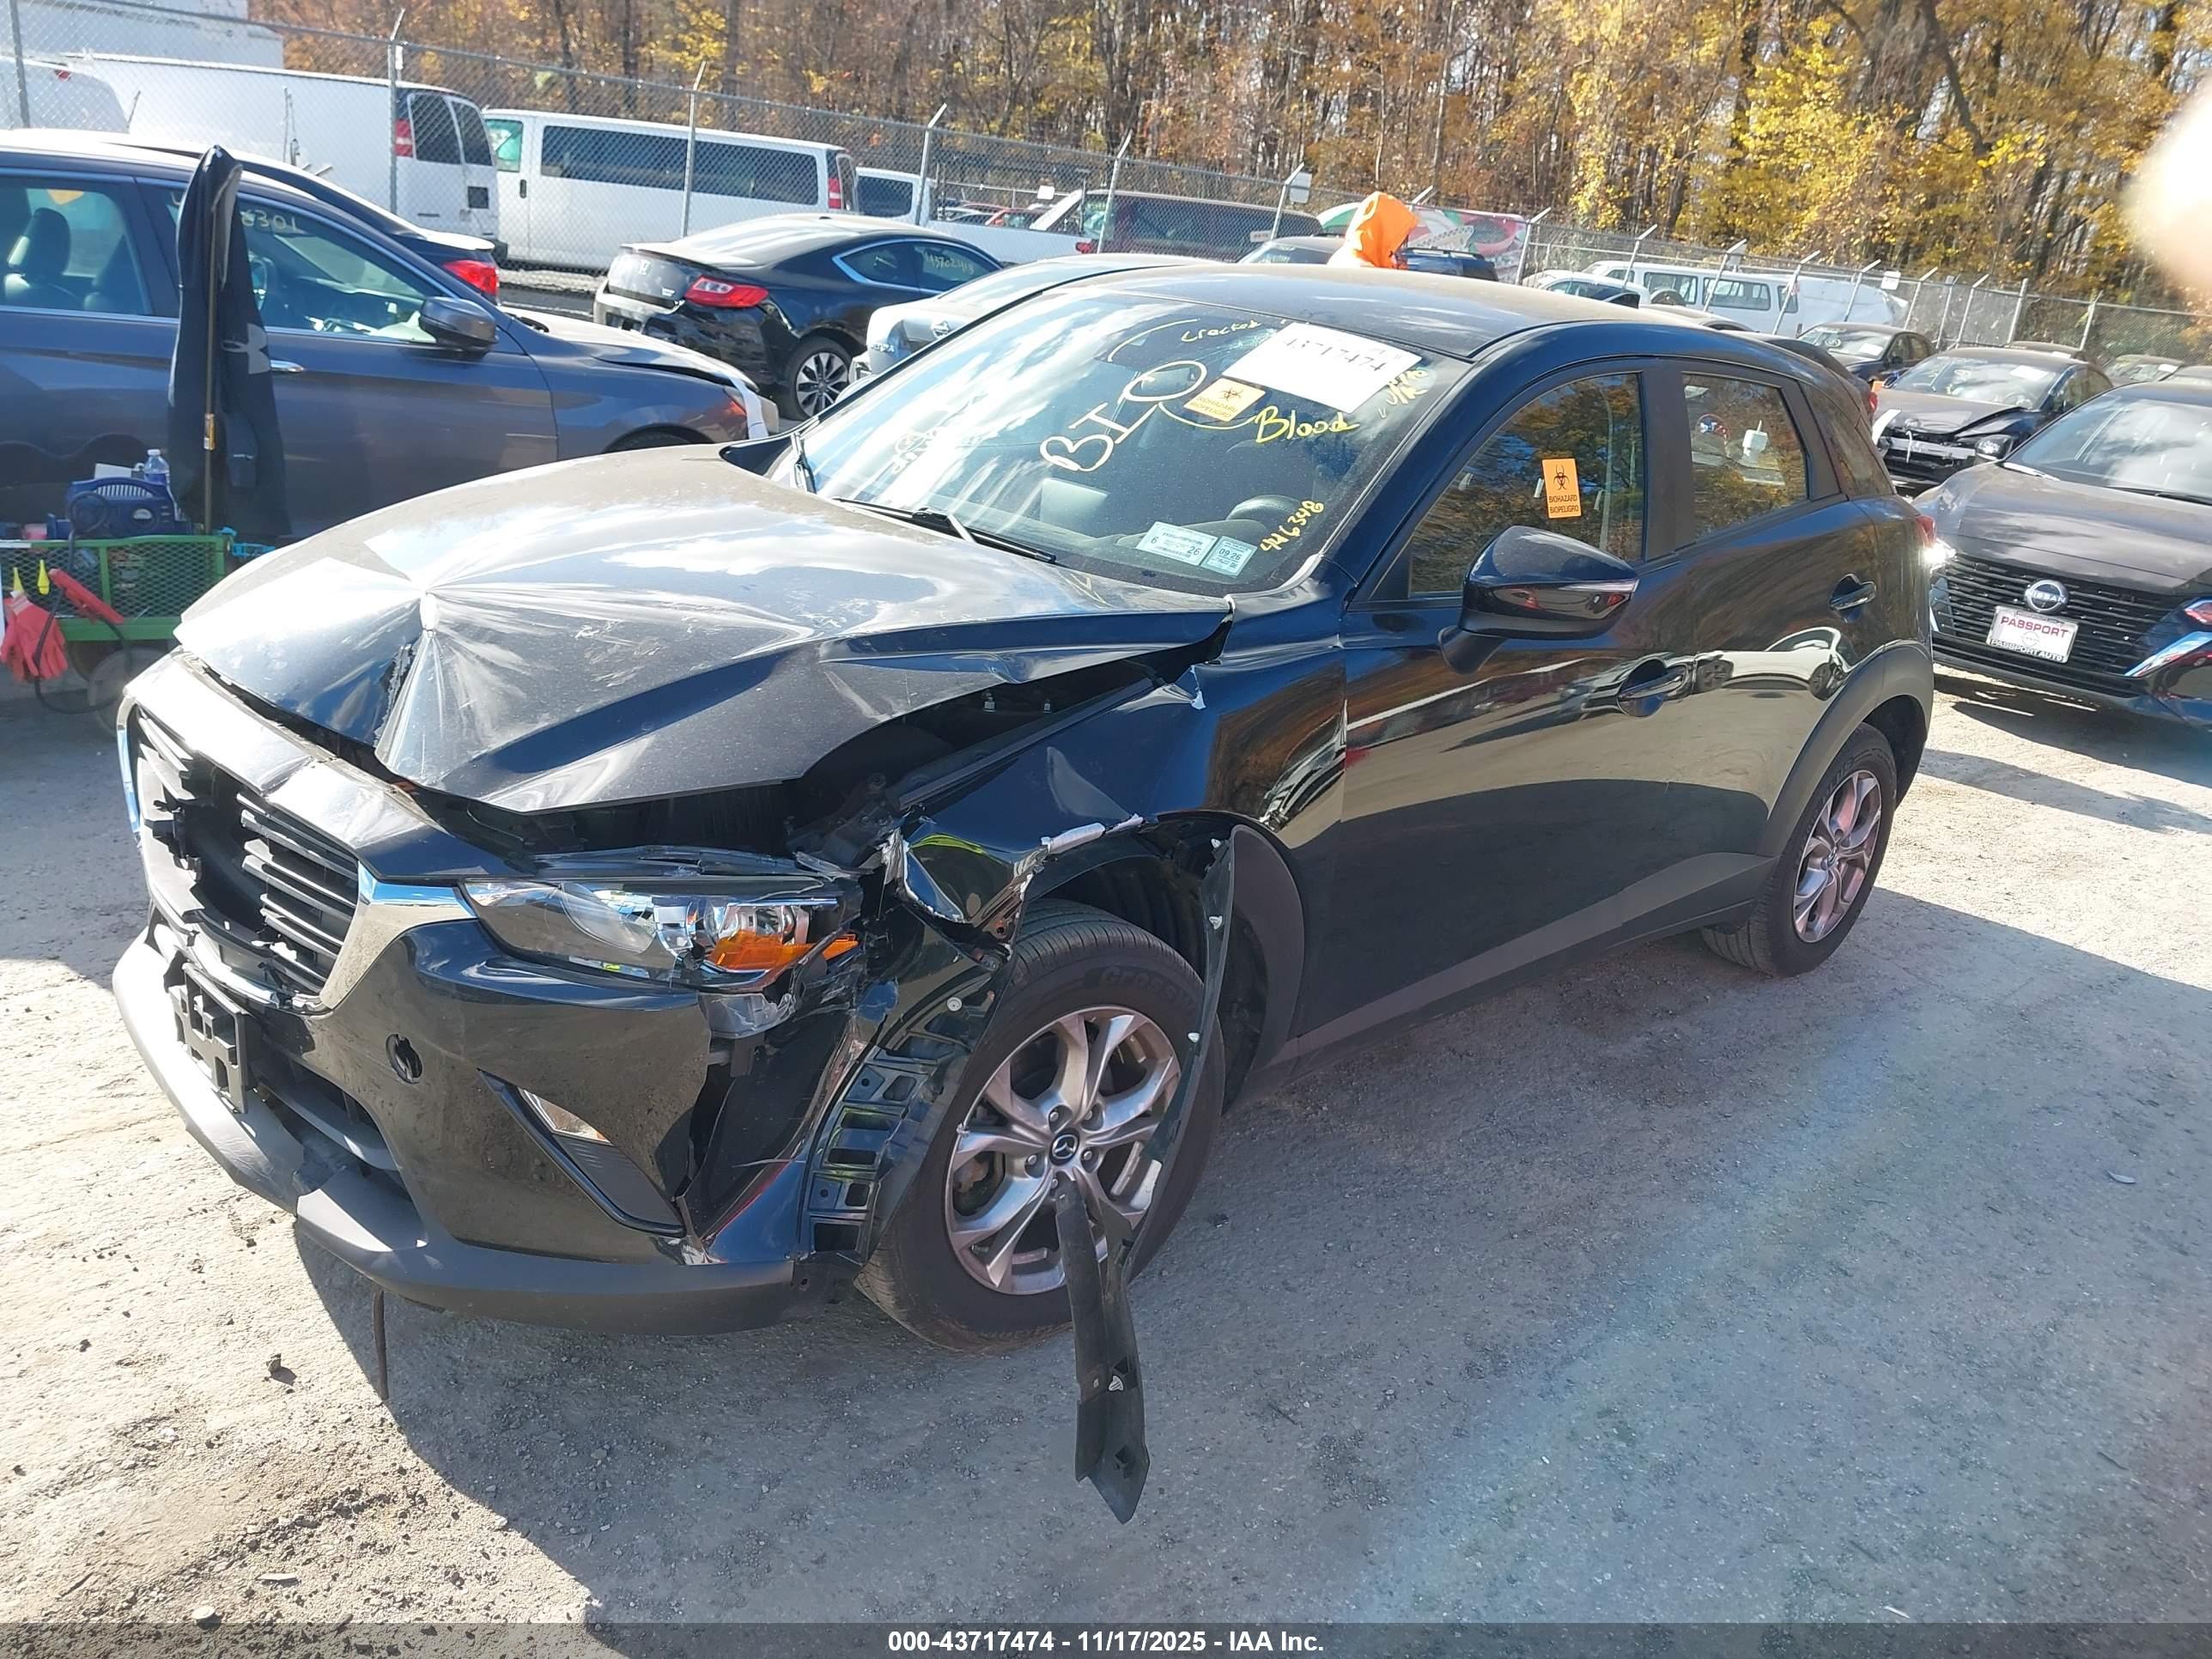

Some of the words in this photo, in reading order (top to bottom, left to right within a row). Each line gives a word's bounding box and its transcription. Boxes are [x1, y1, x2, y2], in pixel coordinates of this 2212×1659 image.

[1039, 360, 1208, 473] BIO
[1255, 405, 1360, 444] Blood
[1548, 494, 1578, 503] BIOHAZARD
[1549, 505, 1579, 514] BIOPELIGRO
[1187, 545, 1202, 556] 26
[1218, 548, 1231, 556] 09
[1231, 552, 1243, 561] 26
[2026, 588, 2067, 604] NISSAN
[2038, 651, 2065, 662] AUTO
